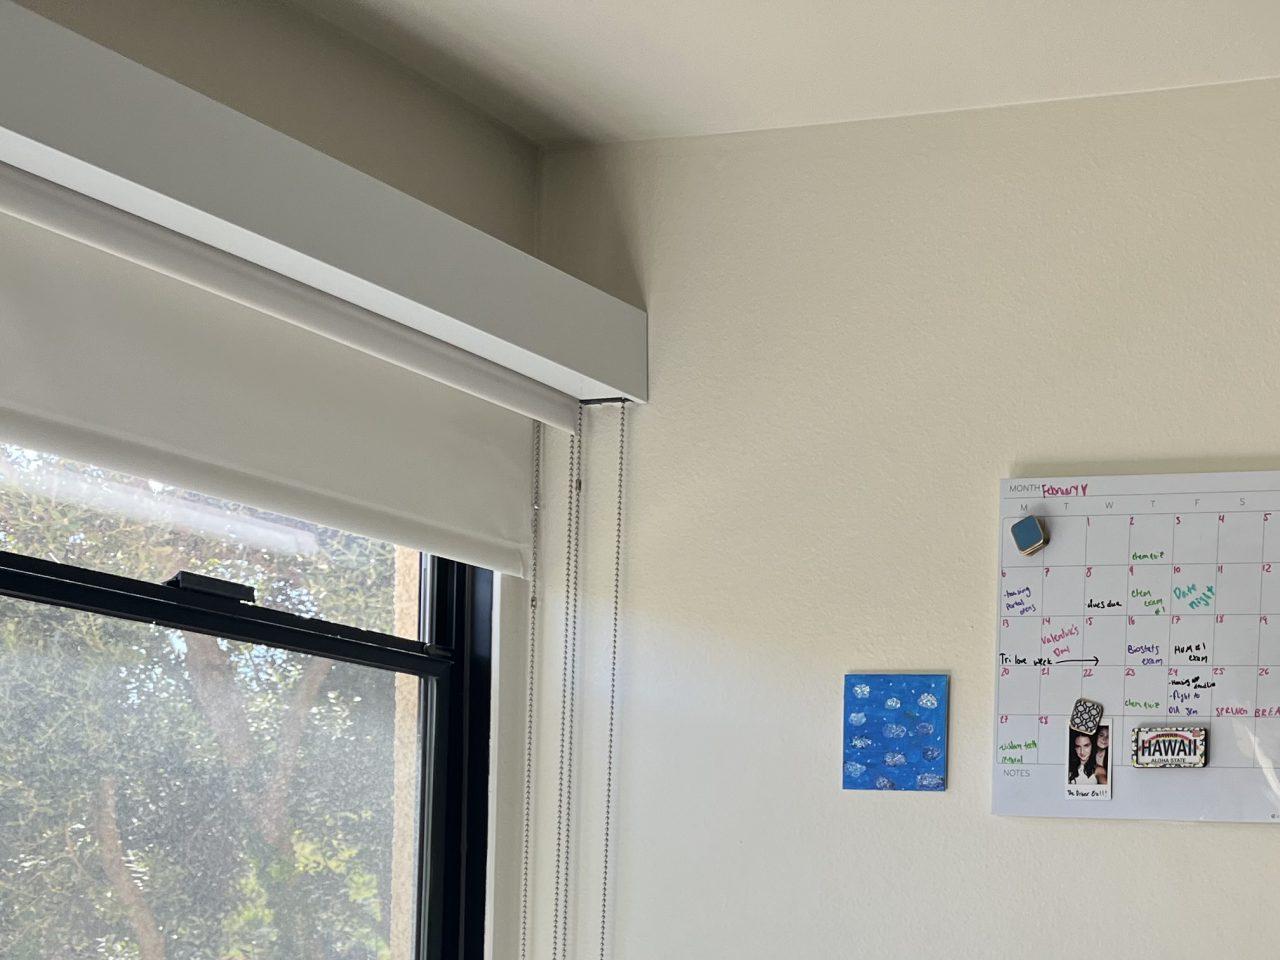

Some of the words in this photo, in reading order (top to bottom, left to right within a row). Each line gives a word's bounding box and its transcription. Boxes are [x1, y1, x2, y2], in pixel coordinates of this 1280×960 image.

[1009, 484, 1040, 493] MONTH
[1041, 484, 1079, 498] February
[1020, 503, 1028, 511] M
[1064, 502, 1070, 510] T
[1105, 501, 1114, 509] W
[1151, 500, 1156, 508] T
[1195, 498, 1201, 507] F
[1240, 498, 1246, 506] S
[1218, 514, 1225, 524] 4
[1263, 513, 1272, 522] 5
[1085, 567, 1092, 577] 8
[1173, 566, 1181, 574] 10
[1262, 563, 1272, 573] 12
[1002, 619, 1009, 628] 13
[1042, 617, 1051, 626] 14
[1085, 616, 1094, 626] 15
[1128, 615, 1135, 626] 16
[1171, 615, 1181, 624] 17
[1216, 614, 1224, 623] 18
[1260, 615, 1268, 625] 19
[1001, 667, 1010, 677] 20
[1041, 667, 1050, 676] 21
[1083, 668, 1094, 677] 22
[1125, 667, 1136, 676] 23
[1168, 667, 1178, 677] 24
[1213, 667, 1226, 676] 25
[1259, 667, 1270, 676] 26
[1215, 706, 1248, 718] SPRING
[1000, 715, 1009, 724] 27
[1039, 715, 1048, 725] 28
[1141, 739, 1197, 757] HAWAII
[1003, 769, 1031, 778] NOTES
